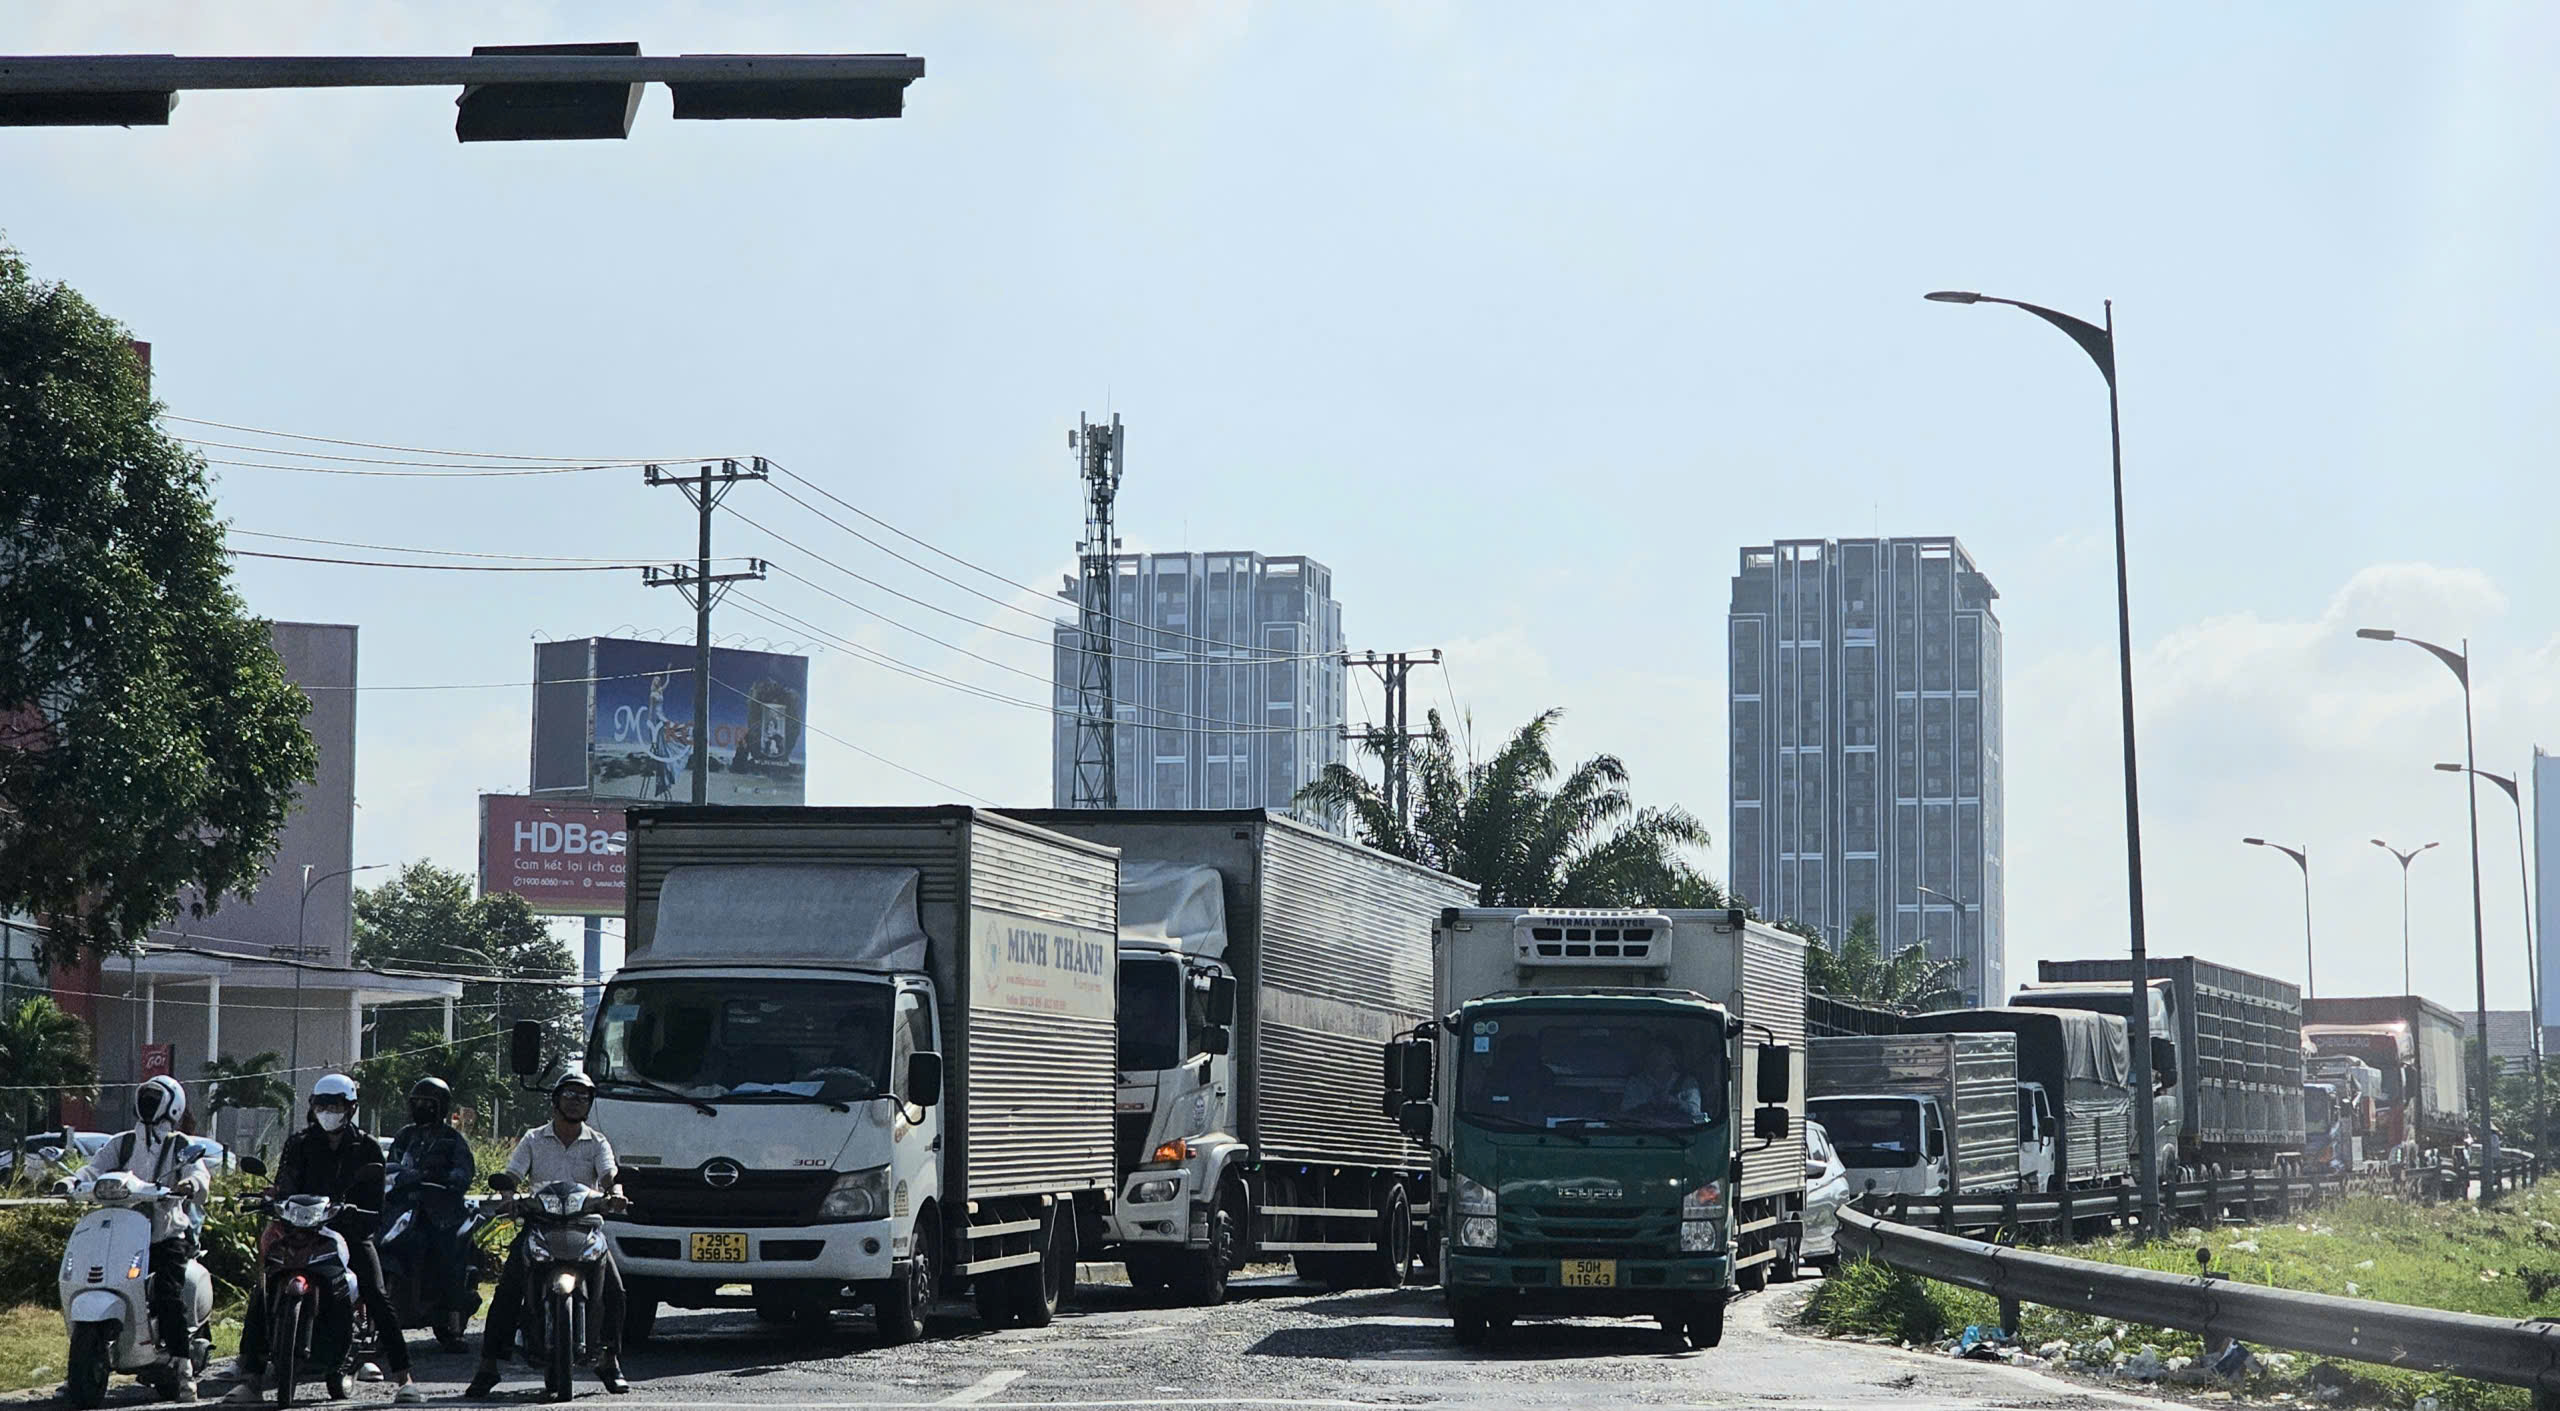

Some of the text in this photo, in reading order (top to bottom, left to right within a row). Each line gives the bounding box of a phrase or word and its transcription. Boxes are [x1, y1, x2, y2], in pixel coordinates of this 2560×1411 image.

[1545, 917, 1646, 928] THERMAL MASTER
[1007, 927, 1104, 977] MINH THÀNH
[792, 1159, 827, 1167] 300
[1558, 1187, 1623, 1200] ISUZU
[706, 1235, 731, 1247] 29C
[696, 1248, 741, 1261] 358.53
[1577, 1261, 1601, 1273] 50H
[1568, 1273, 1611, 1286] 116.43
